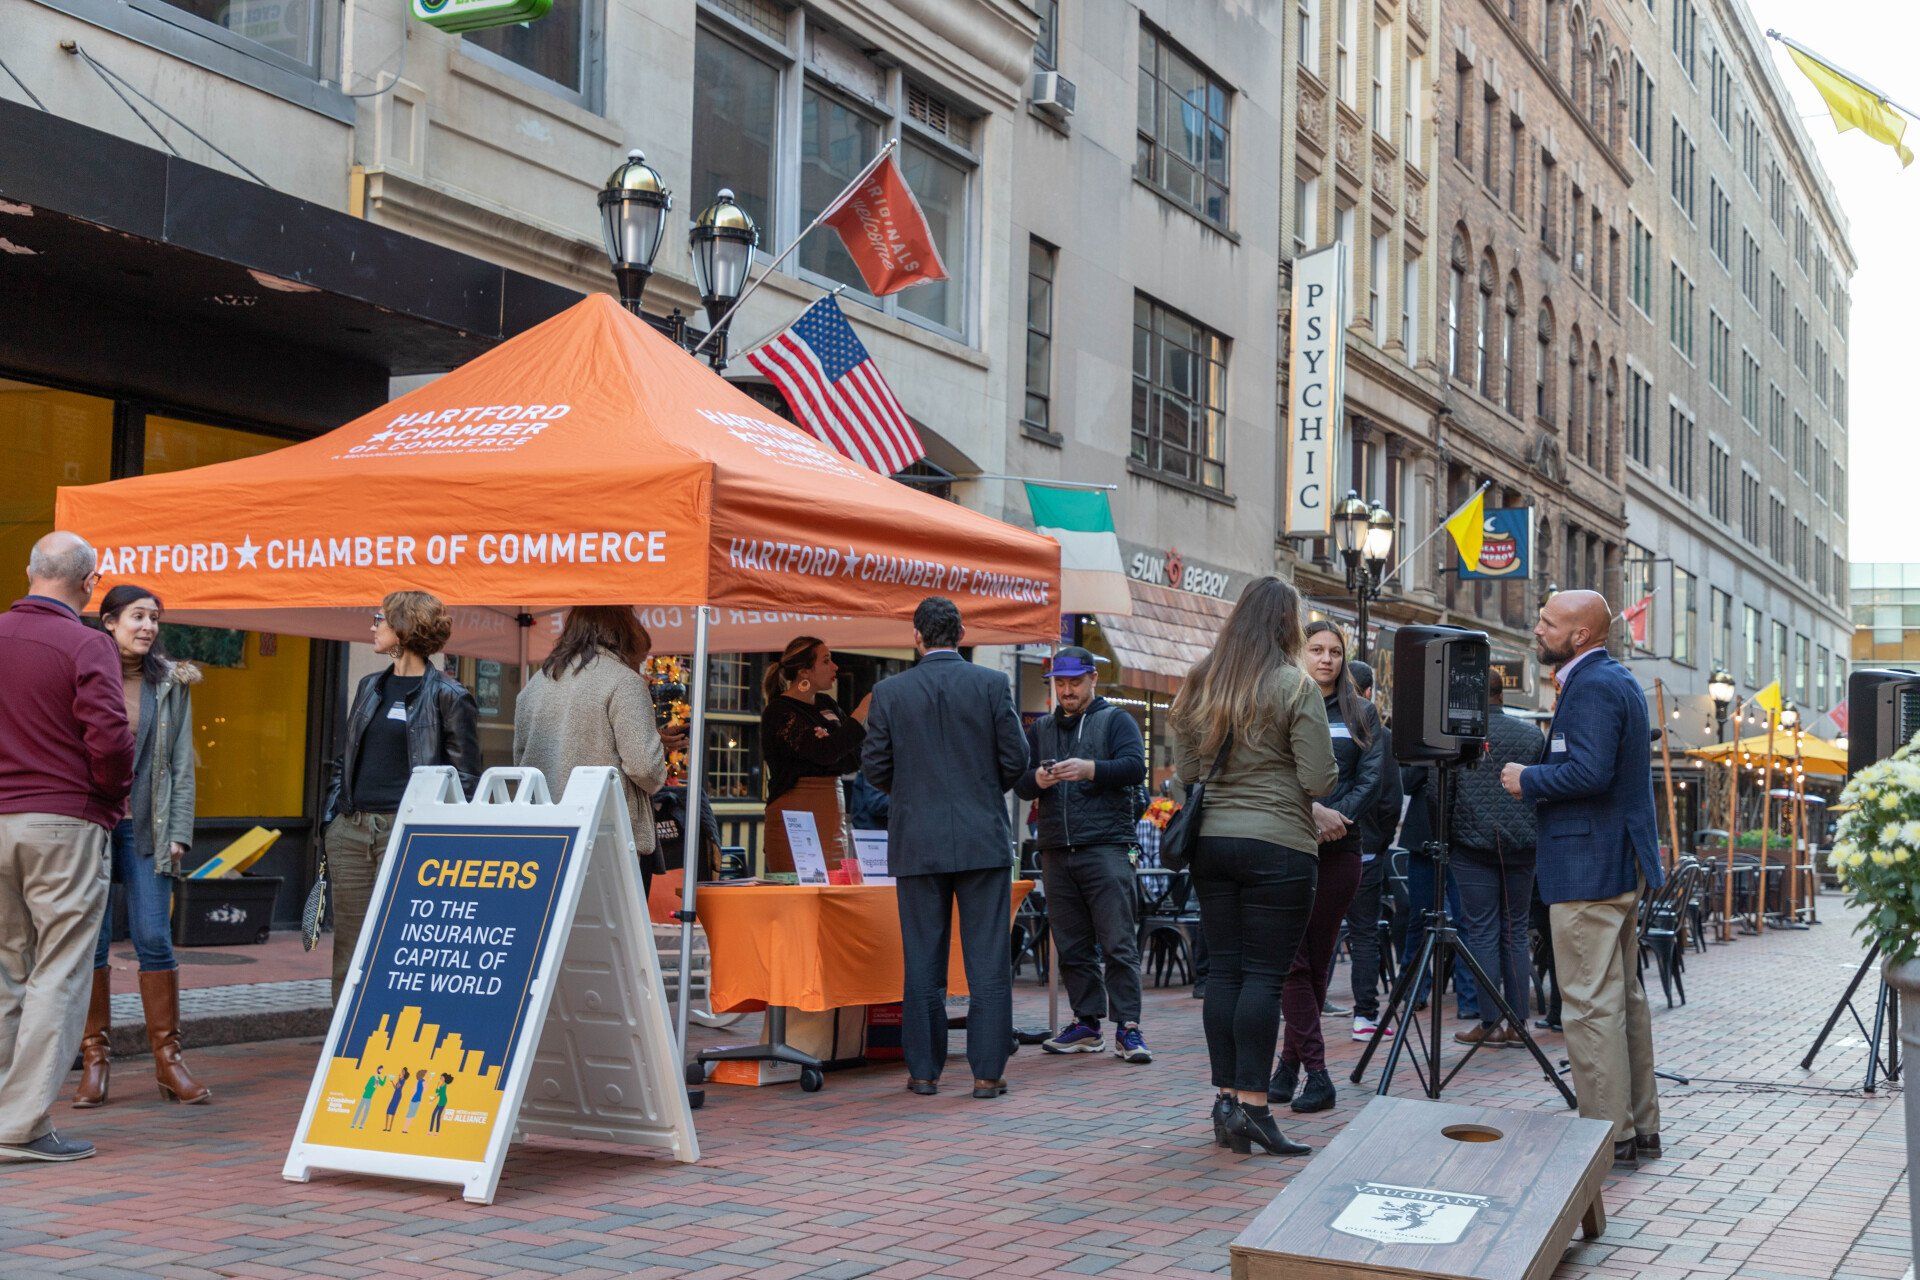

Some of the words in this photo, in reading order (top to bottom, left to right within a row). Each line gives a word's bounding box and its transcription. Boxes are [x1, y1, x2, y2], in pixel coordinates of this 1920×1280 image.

[1299, 283, 1324, 508] PSYCHIC
[386, 404, 571, 428] HARTFORD
[393, 422, 550, 441] CHAMBER
[348, 444, 384, 454] OF
[387, 436, 533, 451] COMMERCE
[267, 536, 416, 569] CHAMBER
[426, 534, 468, 564] OF
[478, 531, 667, 564] COMMERCE
[729, 537, 841, 577] HARTFORD
[861, 552, 947, 589] CHAMBER
[947, 565, 969, 592] OF
[969, 569, 1050, 606] COMMERCE
[1130, 552, 1165, 583] SUN
[1184, 565, 1229, 597] BERRY
[417, 858, 540, 890] CHEERS
[410, 899, 434, 918] TO
[440, 900, 479, 920] THE
[400, 923, 516, 946] INSURANCE
[394, 947, 471, 969] CAPITAL
[479, 951, 508, 970] OF
[388, 971, 426, 991] THE
[430, 974, 502, 996] WORLD
[1354, 1185, 1492, 1209] VAUGHAN'S
